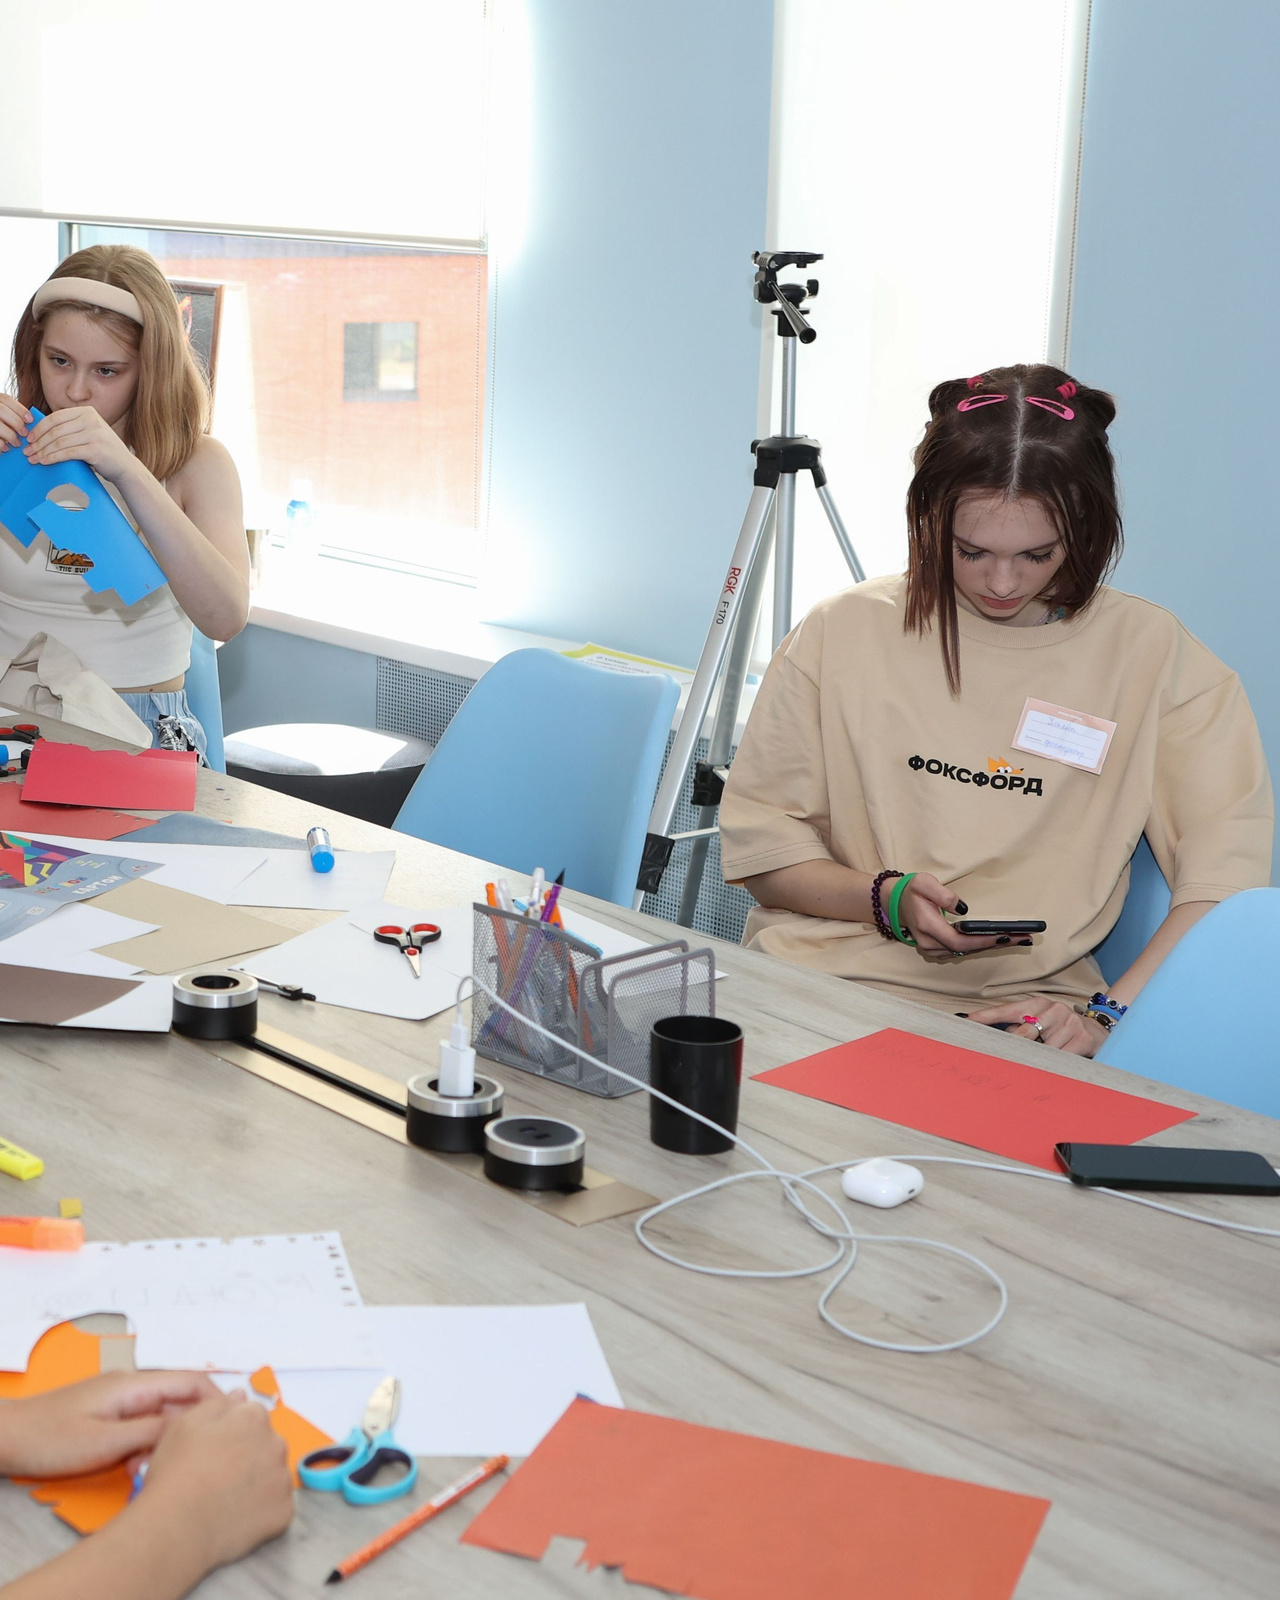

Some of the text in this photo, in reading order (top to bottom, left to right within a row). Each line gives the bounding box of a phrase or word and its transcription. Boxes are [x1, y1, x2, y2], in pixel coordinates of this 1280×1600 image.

[58, 565, 72, 573] THE
[724, 567, 742, 595] RGK
[908, 755, 1043, 796] ФОКСФОРД
